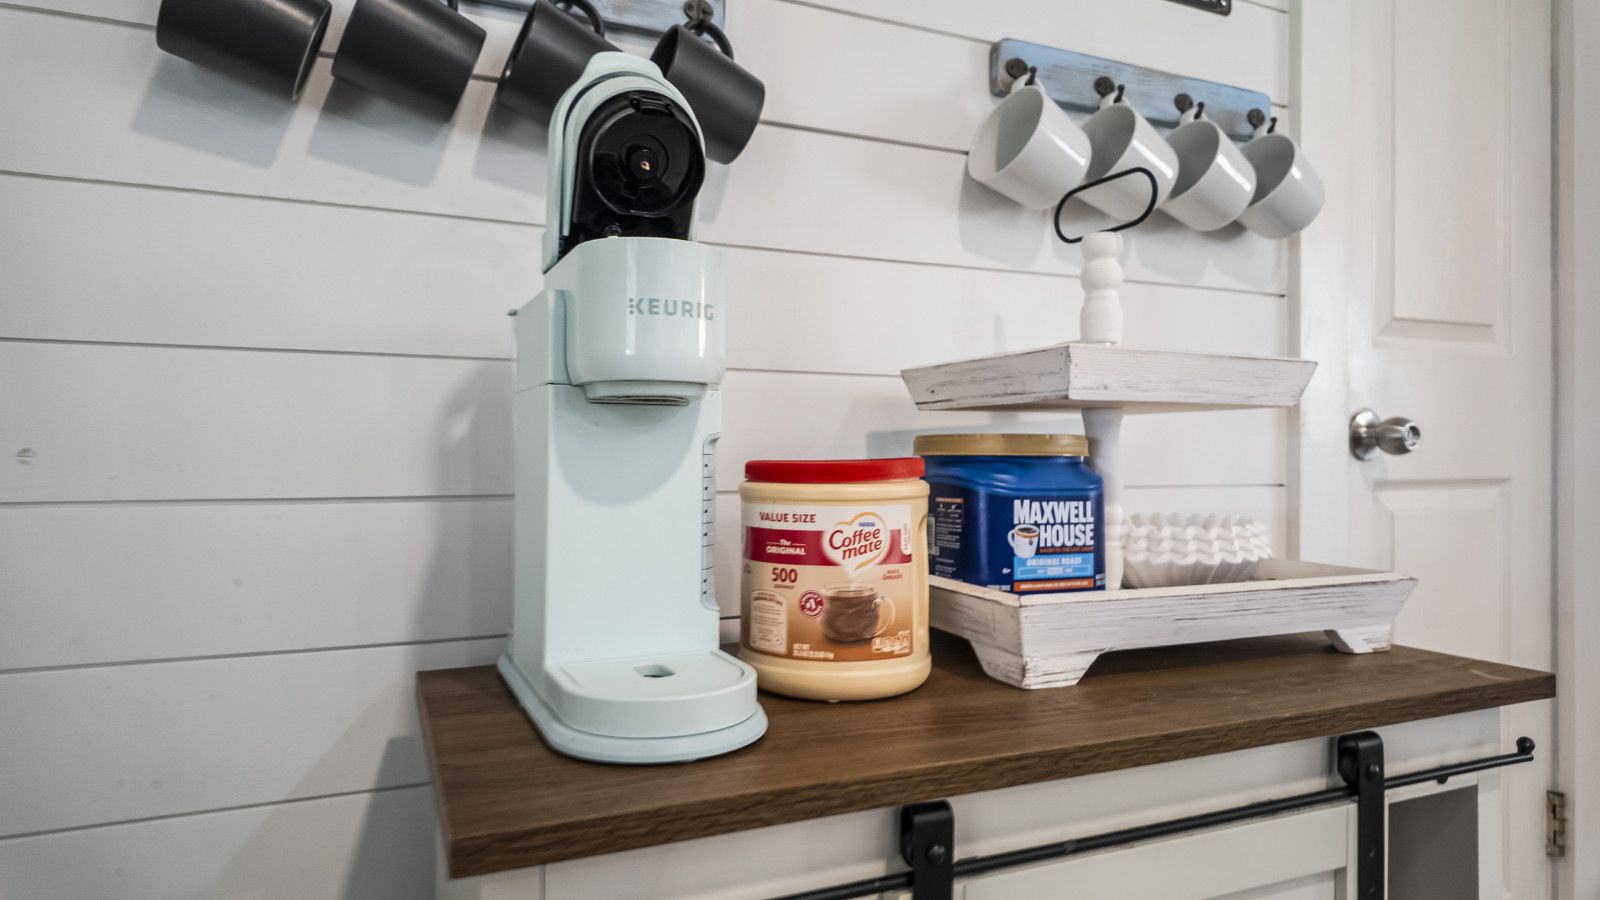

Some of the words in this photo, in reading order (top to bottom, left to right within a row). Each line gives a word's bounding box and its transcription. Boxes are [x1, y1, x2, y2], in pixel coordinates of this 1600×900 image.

[628, 298, 714, 321] KEURIG
[760, 511, 790, 523] VALUE
[792, 513, 816, 523] SIZE
[1014, 499, 1094, 525] MAXWELL
[829, 528, 881, 550] Coffee
[1039, 524, 1094, 547] HOUSE
[766, 545, 806, 555] ORIGINAL
[842, 539, 882, 560] mate
[1027, 558, 1060, 566] ORIGINAL
[1061, 556, 1082, 565] ROAST
[772, 567, 798, 583] 500
